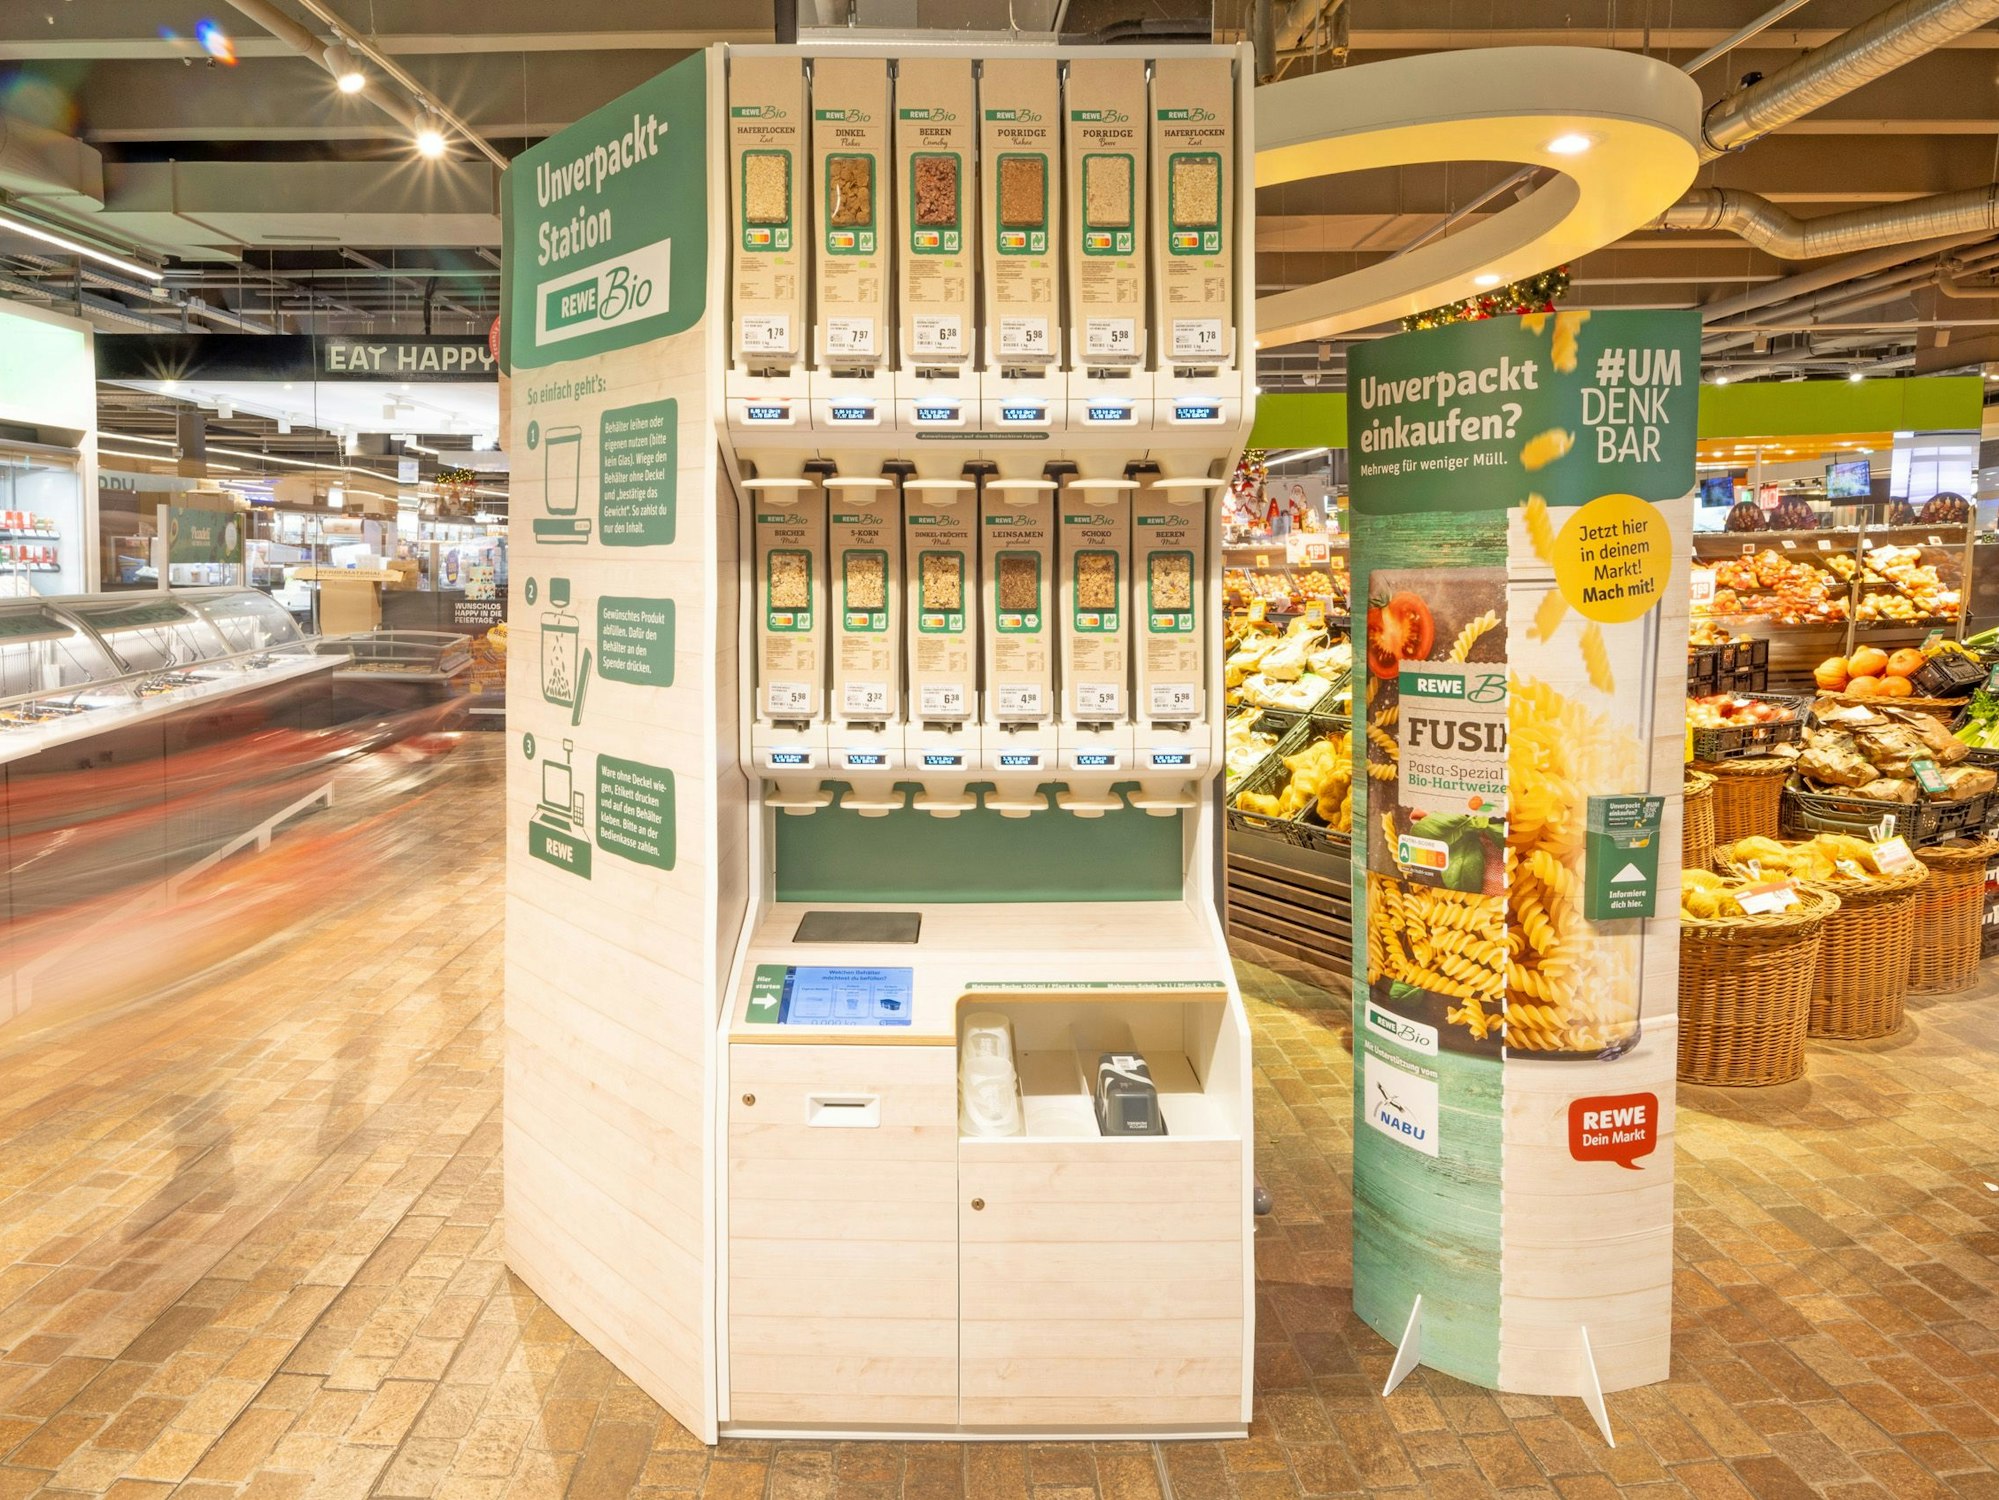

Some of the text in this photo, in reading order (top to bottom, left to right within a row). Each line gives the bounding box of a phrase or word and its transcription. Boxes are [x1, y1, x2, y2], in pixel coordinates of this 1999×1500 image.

[761, 106, 786, 119] Bio
[845, 110, 870, 123] Bio
[929, 108, 956, 122] Bio
[1016, 109, 1041, 122] Bio
[1101, 110, 1128, 123] Bio
[1188, 108, 1215, 122] Bio
[537, 113, 669, 208] Unverpackt-
[538, 206, 612, 266] Station
[561, 266, 652, 320] REWE Bio
[330, 344, 494, 371] EAT HAPPY
[1596, 348, 1682, 386] #UM
[1360, 356, 1538, 410] Unverpackt
[528, 387, 538, 405] So
[540, 382, 572, 403] einfach
[1581, 387, 1670, 426] DENK
[606, 416, 664, 434] Behälter leihen oder
[1360, 403, 1522, 453] einkaufen?
[531, 428, 535, 442] 1
[605, 434, 666, 451] eigenen nutzen (bitte
[1596, 426, 1661, 463] BAR
[605, 451, 667, 468] kein Glas). Wiege den
[1361, 452, 1507, 477] Mehrweg für weniger Müll.
[605, 468, 665, 484] Behälter ohne Deckel
[604, 489, 616, 500] und
[647, 486, 657, 498] das
[632, 504, 640, 516] So
[641, 503, 657, 516] zahlst
[659, 504, 667, 515] du
[604, 521, 645, 534] nur den Inhalt.
[785, 514, 807, 525] Bio
[860, 514, 883, 525] Bio
[936, 514, 960, 526] Bio
[1013, 515, 1037, 526] Bio
[1091, 515, 1114, 526] Bio
[1165, 515, 1188, 527] Bio
[1579, 520, 1648, 542] Jetzt hier
[1581, 542, 1650, 562] in deinem
[1594, 560, 1642, 581] Markt!
[528, 586, 533, 598] 2
[1583, 578, 1654, 604] Mach mit!
[603, 607, 665, 625] Gewünschtes Produkt
[603, 625, 657, 641] abfüllen. Dafür den
[603, 641, 647, 656] Behälter an den
[603, 656, 652, 674] Spender drücken.
[1418, 679, 1462, 694] REWE
[526, 740, 532, 754] 3
[1409, 759, 1504, 780] Pasta-Spezial
[602, 765, 667, 793] Ware ohne Deckel wie-
[601, 784, 659, 808] gen, Etikett drucken
[601, 798, 662, 824] und auf den Behälter
[601, 813, 658, 839] kleben. Bitte an der
[546, 836, 573, 863] REWE
[601, 828, 660, 857] Bedienkasse zahlen.
[1610, 890, 1646, 898] Informiere
[1377, 1016, 1430, 1047] REWE Bio
[1364, 1040, 1438, 1079] Mit Unterstützung vom
[1380, 1110, 1425, 1141] NABU
[1583, 1106, 1646, 1131] REWE
[1583, 1129, 1645, 1147] Dein Markt
